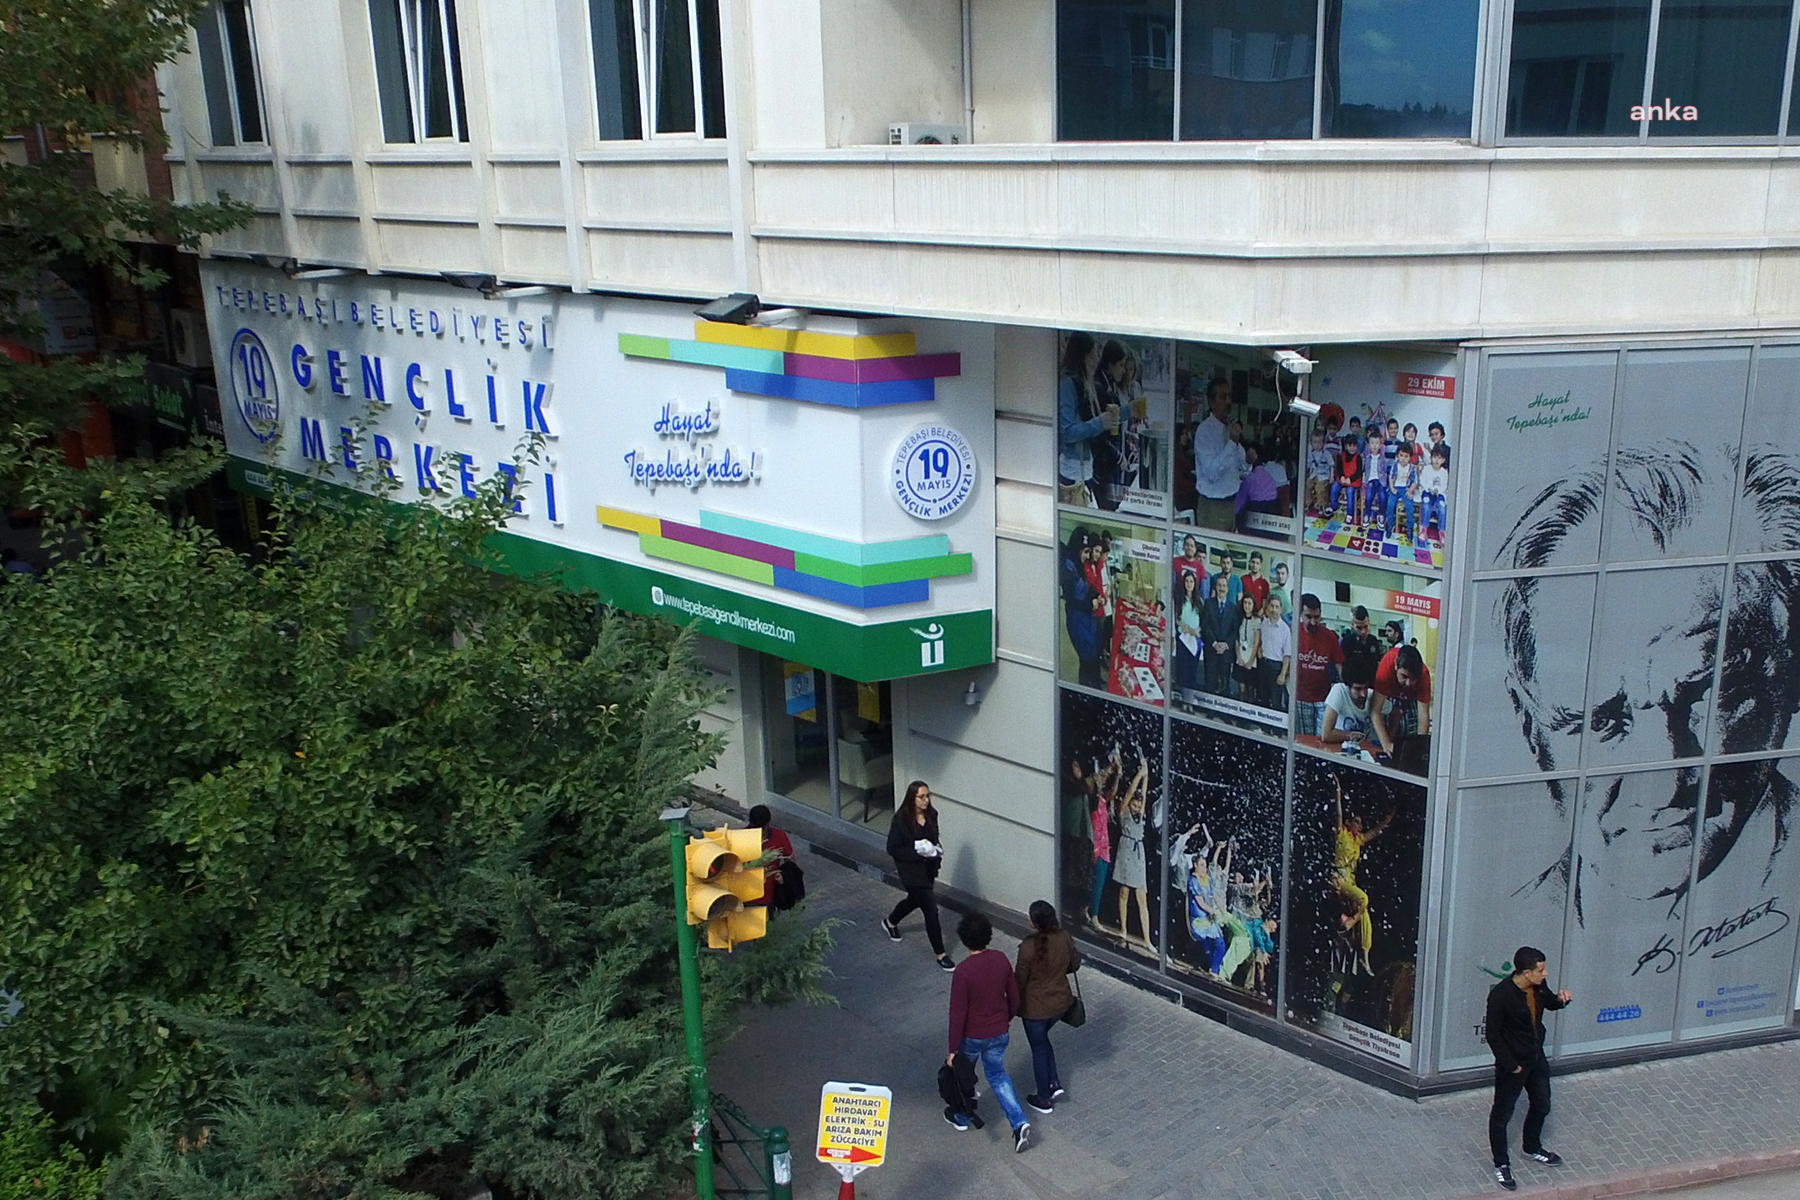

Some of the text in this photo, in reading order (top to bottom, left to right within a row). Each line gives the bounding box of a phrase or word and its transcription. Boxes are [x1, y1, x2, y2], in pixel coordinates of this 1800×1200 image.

[217, 286, 548, 348] TEPEBAŞI BELEDİYESİ
[238, 344, 267, 398] 19
[291, 343, 551, 433] GENÇLİK
[1407, 376, 1445, 390] 29 EKİM
[1527, 389, 1571, 411] Hayat
[654, 400, 712, 442] Hayat
[897, 427, 972, 464] TEPEBAŞI BELEDİYESİ
[300, 417, 558, 522] MERKEZİ
[918, 447, 949, 480] 19
[895, 473, 973, 516] GENÇLİK MERKEZİ
[917, 479, 951, 491] MAYIS
[1395, 595, 1431, 609] 19 MAYIS
[1369, 1031, 1401, 1049] Belediyesi
[832, 1096, 881, 1107] ANAHTARCI
[834, 1106, 878, 1117] HIRDAVAT
[825, 1115, 866, 1125] ELEKTRİK
[873, 1119, 885, 1128] SU
[825, 1125, 882, 1137] ARIZA BAKIM
[830, 1134, 876, 1147] ZÜCCACİYE
